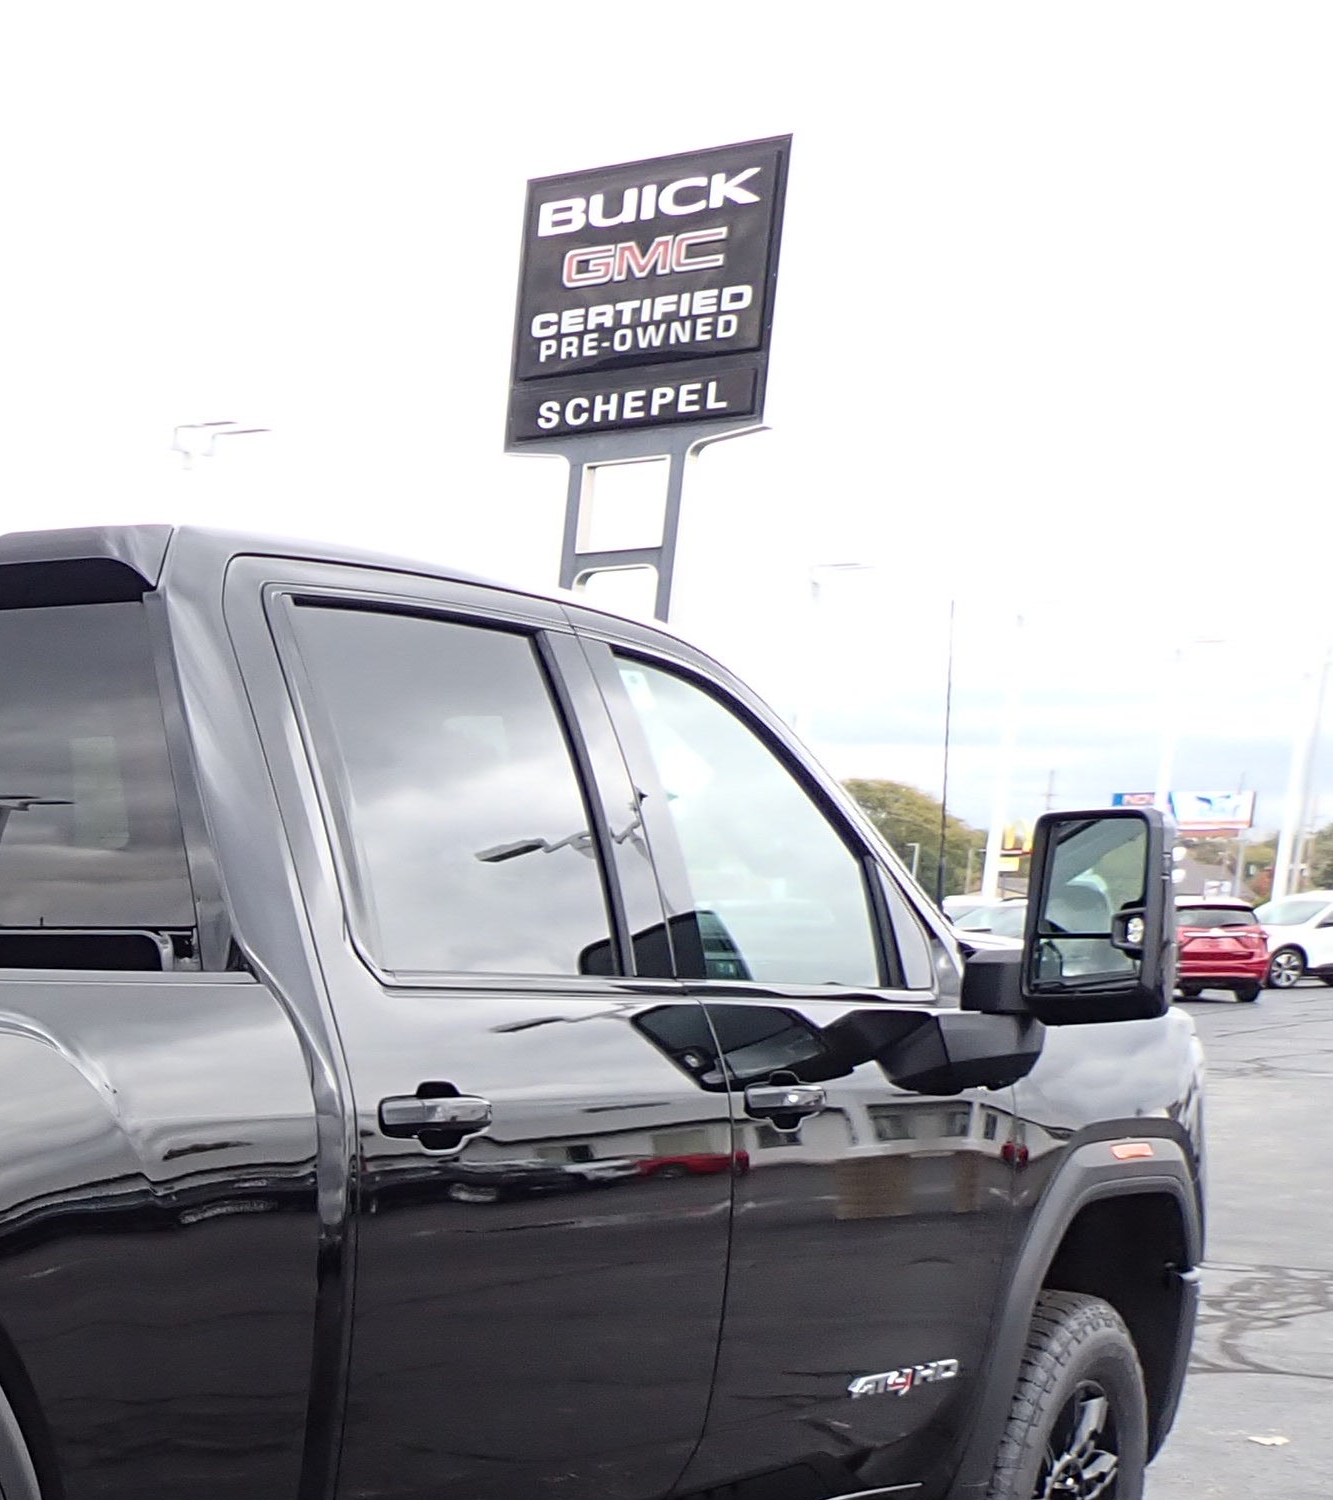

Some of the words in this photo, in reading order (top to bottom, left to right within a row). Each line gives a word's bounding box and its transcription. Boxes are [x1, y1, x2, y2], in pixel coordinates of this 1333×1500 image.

[537, 167, 762, 237] BUICK
[561, 226, 728, 289] GMC
[531, 285, 754, 338] CERTIFIED
[538, 314, 739, 363] PRE-OWNED
[536, 380, 728, 430] SCHEPEL
